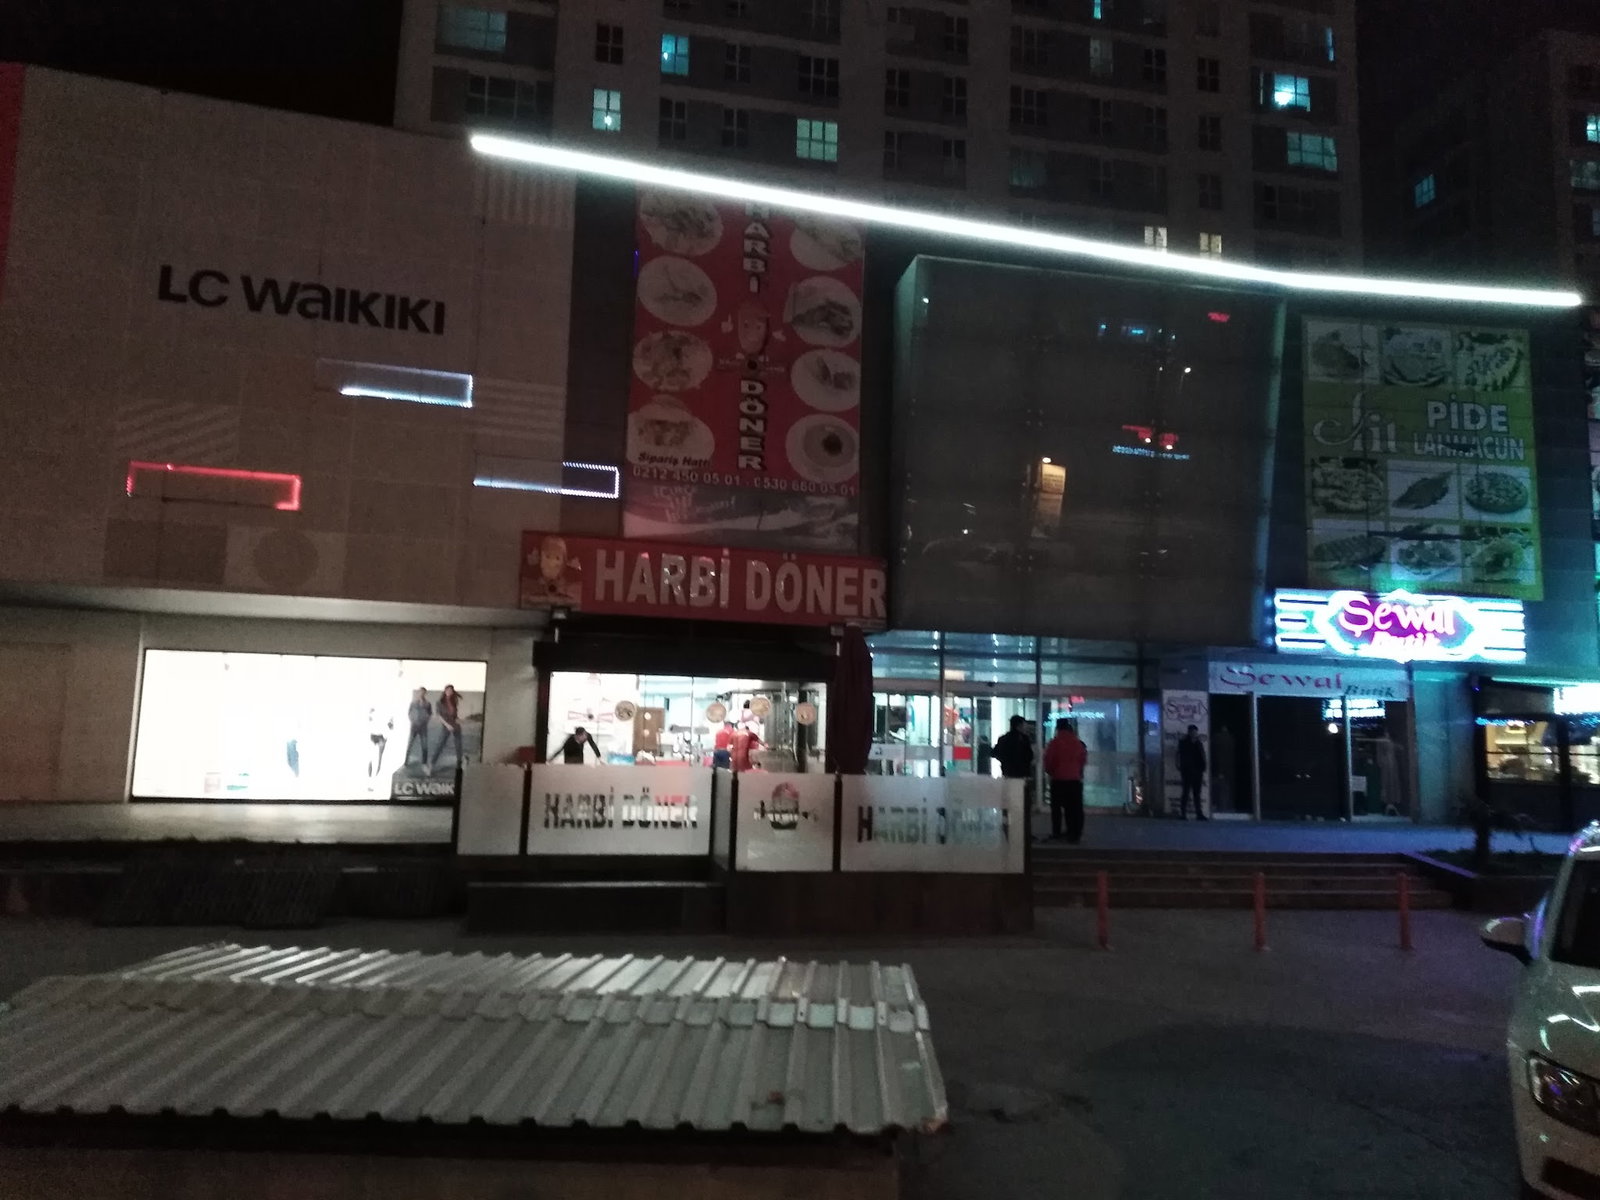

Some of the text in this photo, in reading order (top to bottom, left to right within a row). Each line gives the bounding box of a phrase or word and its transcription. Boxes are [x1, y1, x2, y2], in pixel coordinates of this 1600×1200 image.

[158, 264, 229, 307] LC
[1426, 393, 1509, 433] PİDE
[632, 465, 669, 480] 0212
[702, 472, 720, 486] 05
[724, 474, 741, 487] 01
[840, 484, 857, 496] 01
[594, 547, 887, 620] HARBİ DÖNER
[394, 782, 414, 796] LC
